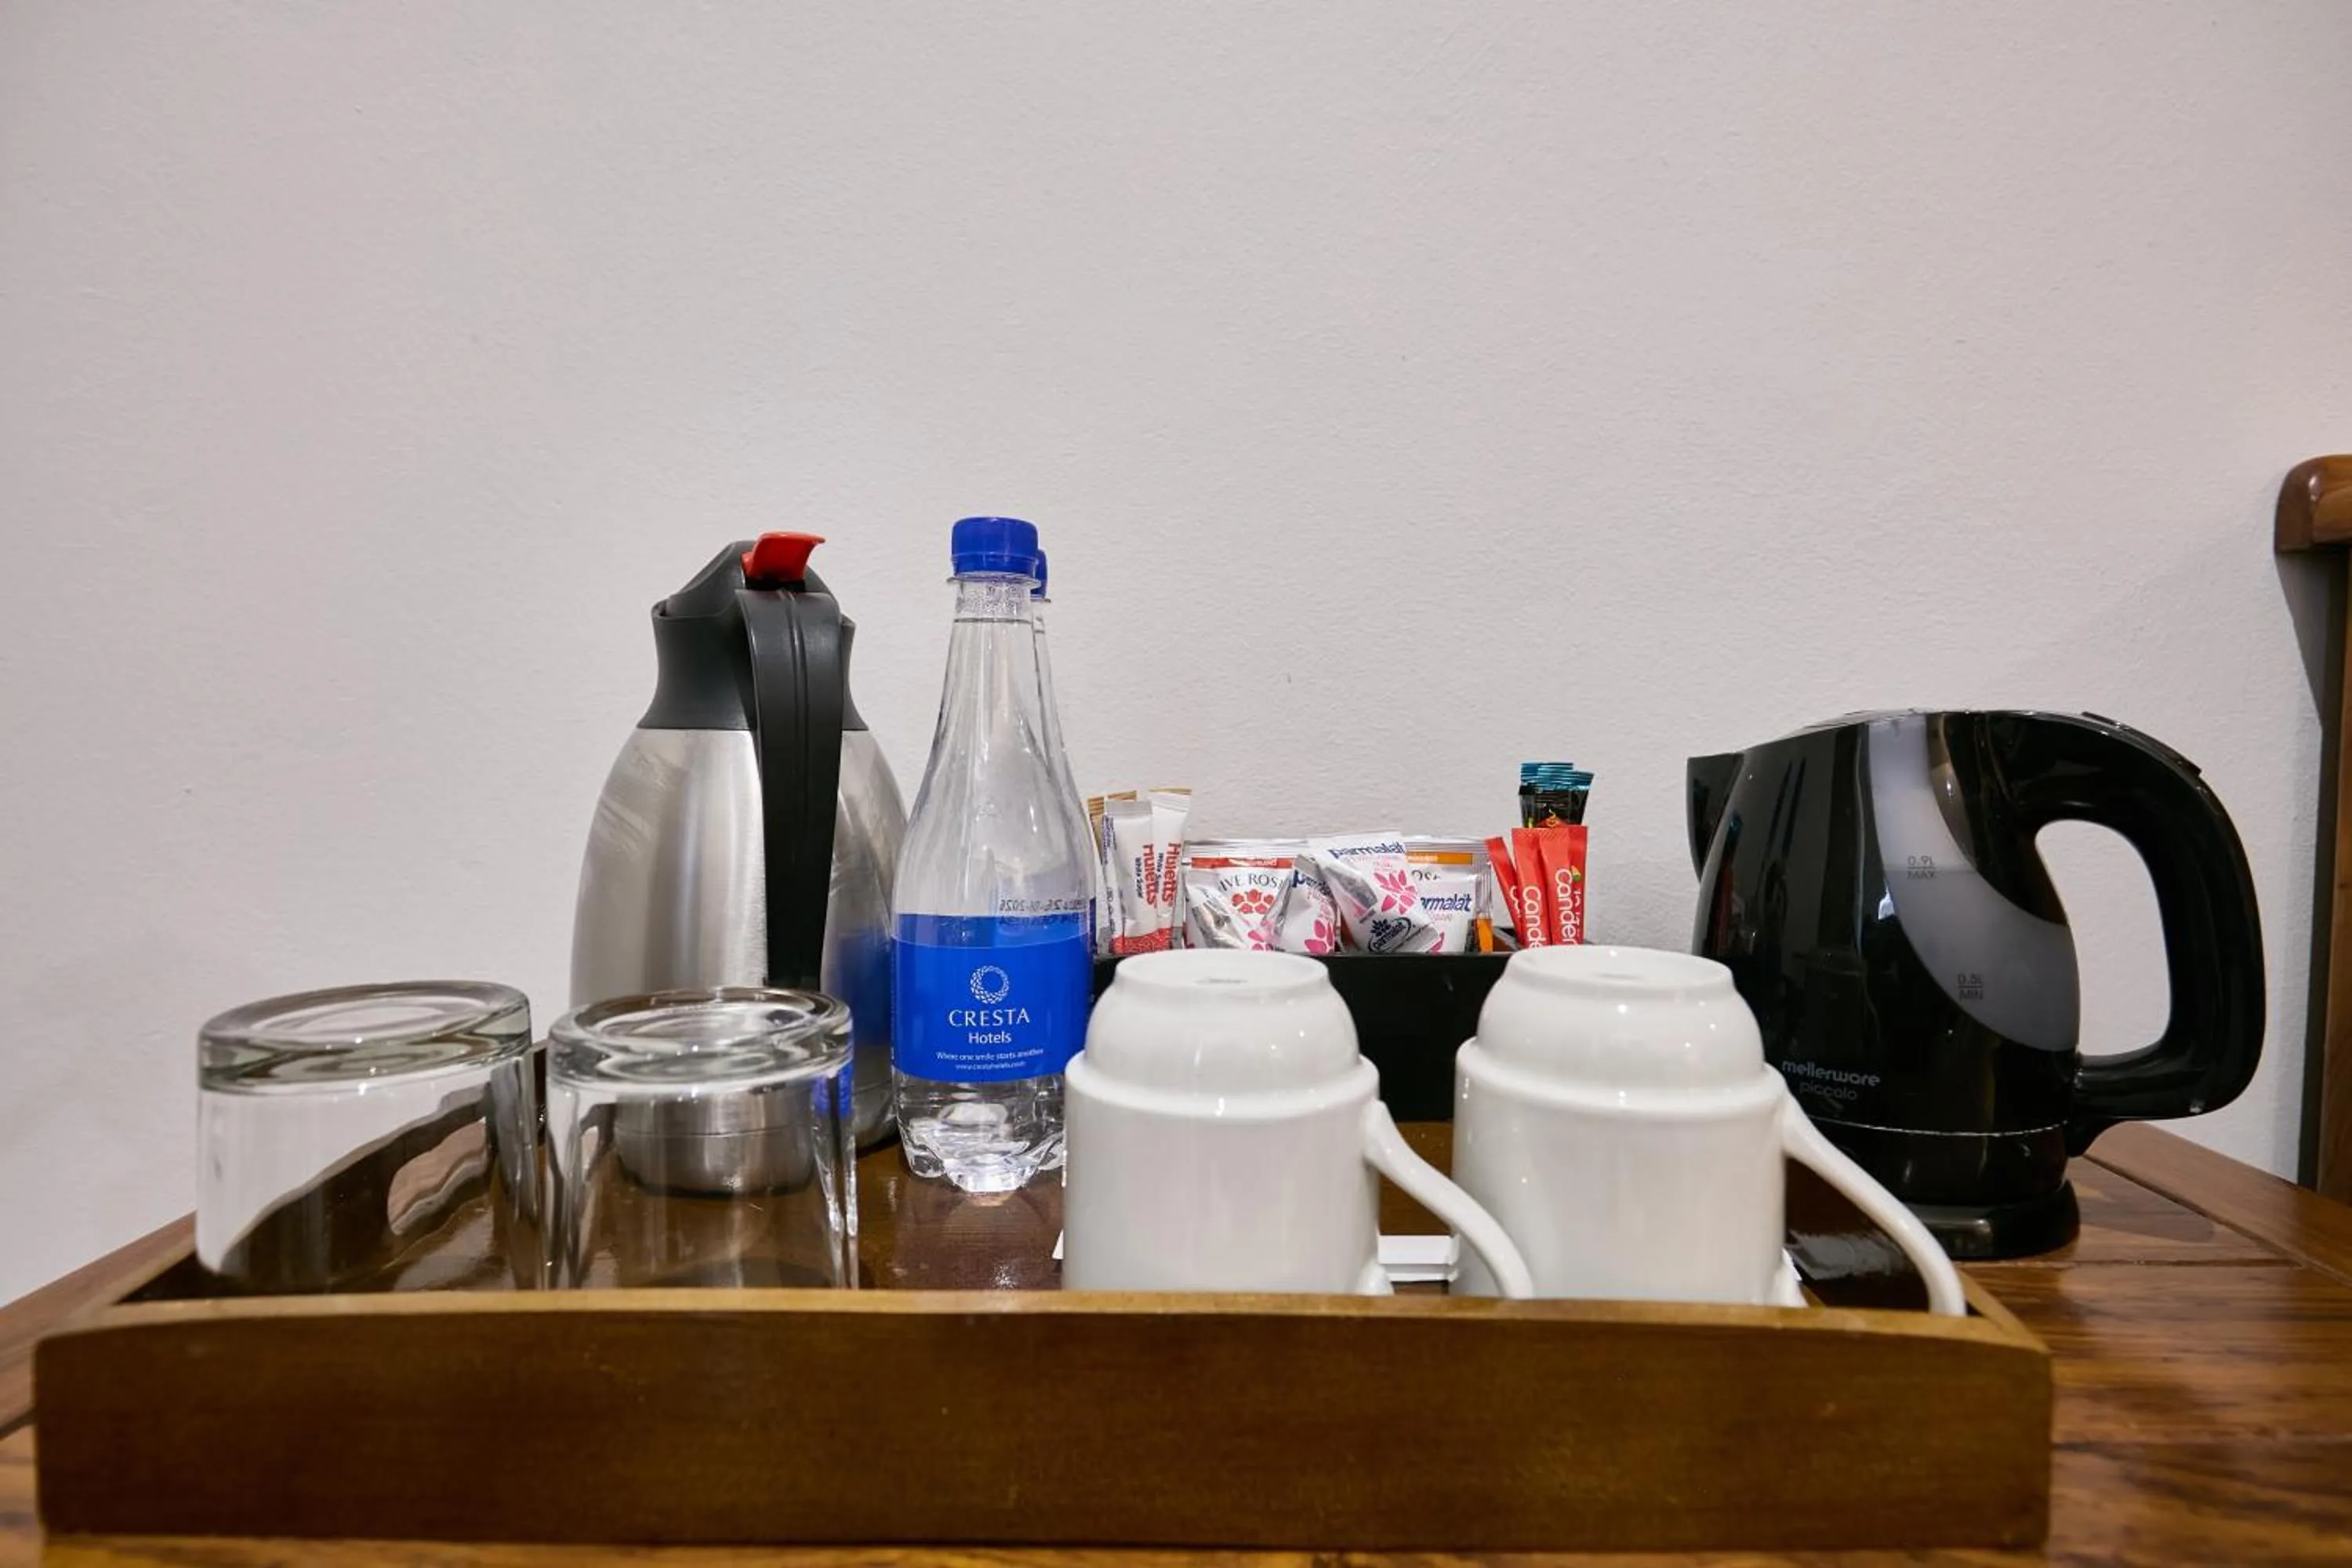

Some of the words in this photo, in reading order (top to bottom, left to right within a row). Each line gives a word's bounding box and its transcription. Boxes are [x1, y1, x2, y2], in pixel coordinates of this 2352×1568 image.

[1162, 843, 1181, 902] Huletts
[1248, 872, 1286, 889] ROS
[1523, 885, 1545, 948] cande
[1555, 868, 1577, 945] cander
[949, 1007, 1030, 1027] CRESTA
[968, 1031, 1012, 1044] Hotels
[936, 1051, 958, 1061] Where
[1782, 1060, 1881, 1087] mellerware
[1799, 1081, 1857, 1101] piccolo
